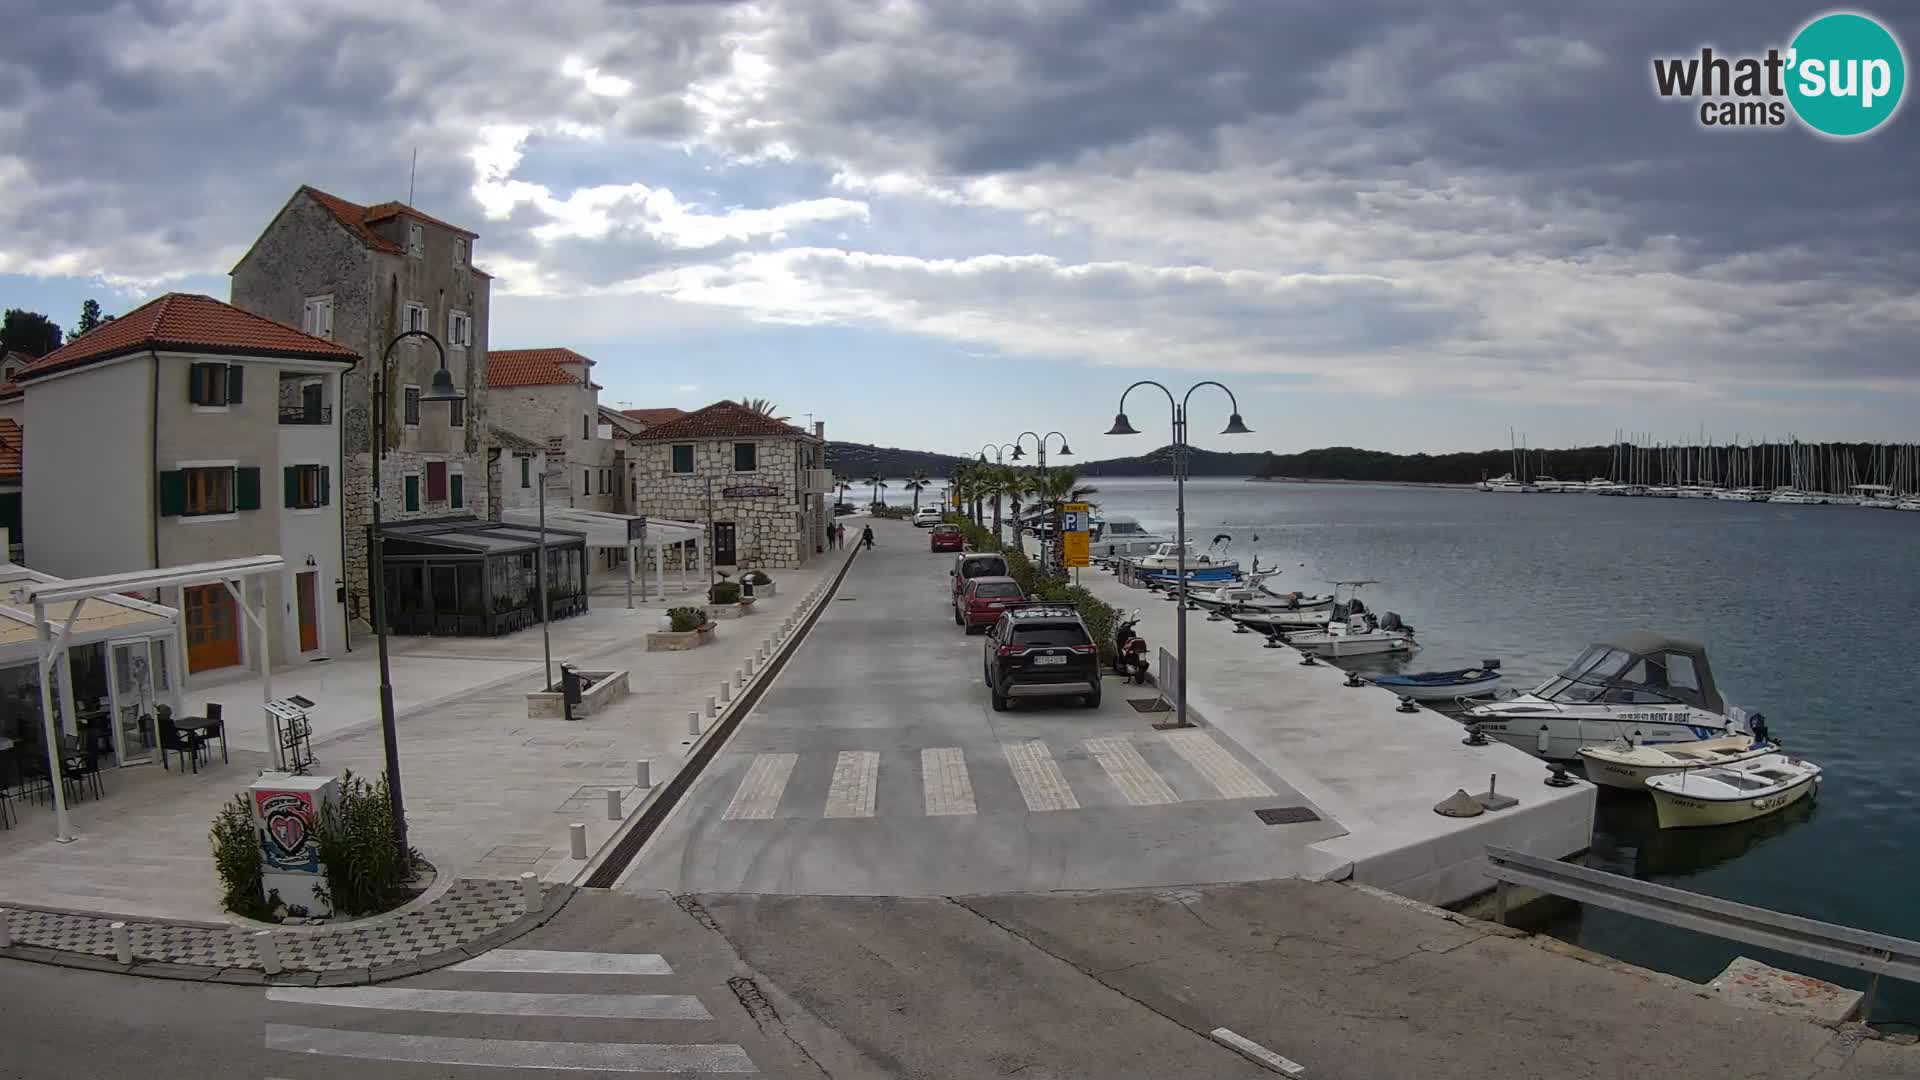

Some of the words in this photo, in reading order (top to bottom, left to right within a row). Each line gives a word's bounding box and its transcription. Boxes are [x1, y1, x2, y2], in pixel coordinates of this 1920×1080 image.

[1066, 514, 1076, 529] P
[1649, 712, 1668, 721] RENT
[1674, 713, 1690, 723] BOAT
